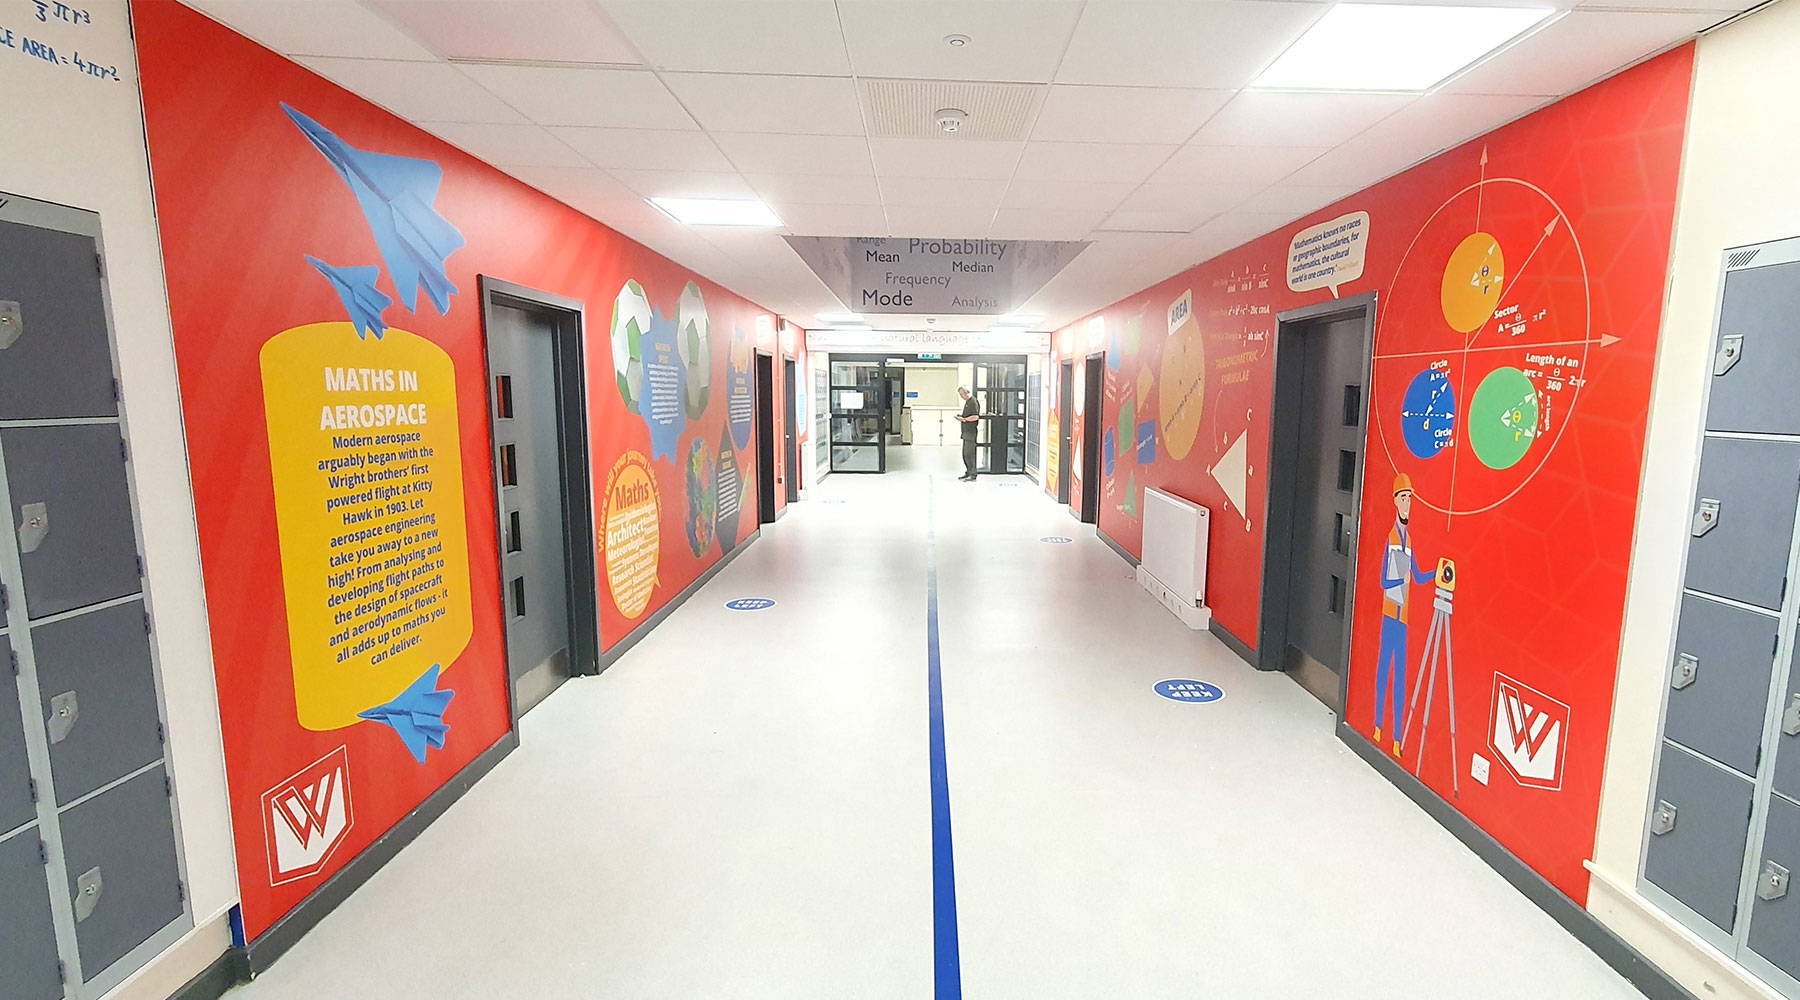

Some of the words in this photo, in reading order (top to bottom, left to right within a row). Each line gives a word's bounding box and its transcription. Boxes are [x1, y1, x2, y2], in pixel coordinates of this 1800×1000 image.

[22, 37, 59, 65] AREA
[1346, 218, 1362, 231] races
[1351, 231, 1360, 243] for
[866, 249, 900, 263] Mean
[909, 238, 1007, 261] Probability
[1321, 253, 1330, 264] the
[1330, 246, 1350, 261] cultural
[952, 261, 994, 273] Median
[1308, 270, 1317, 280] one
[885, 272, 951, 288] Frequency
[862, 289, 913, 306] Mode
[951, 296, 998, 310] Analysis
[1170, 298, 1188, 326] AREA
[1494, 304, 1520, 319] Sector
[1497, 323, 1504, 333] A
[1511, 324, 1526, 336] 360
[1430, 360, 1448, 370] Circle
[1526, 352, 1555, 366] Length
[1555, 356, 1566, 366] of
[325, 367, 395, 392] MATHS
[399, 370, 418, 392] IN
[1430, 373, 1436, 382] A
[1523, 368, 1536, 378] arc
[1546, 380, 1562, 391] 360
[1431, 390, 1437, 399] r
[320, 403, 427, 431] AEROSPACE
[1423, 418, 1430, 431] d
[332, 435, 373, 449] Modern
[375, 432, 421, 446] aerospace
[1434, 428, 1452, 438] Circle
[318, 453, 366, 473] arguably
[367, 452, 397, 466] began
[398, 448, 418, 460] with
[419, 446, 434, 458] the
[328, 474, 366, 490] Wright
[411, 464, 429, 476] first
[326, 490, 373, 512] powered
[375, 485, 400, 503] flight
[402, 484, 411, 494] at
[412, 480, 433, 493] Kitty
[615, 478, 649, 512] Maths
[343, 508, 373, 525] Hawk
[374, 506, 384, 519] in
[386, 501, 409, 515] 1903.
[410, 499, 424, 510] Let
[330, 526, 383, 549] aerospace
[384, 513, 436, 534] engineering
[330, 553, 354, 568] take
[356, 546, 375, 563] you
[377, 539, 402, 555] away
[403, 535, 413, 546] to
[414, 534, 420, 543] a
[421, 528, 439, 541] new
[328, 569, 355, 588] high!
[357, 562, 382, 578] From
[384, 549, 426, 568] analysing
[427, 541, 442, 555] and
[327, 580, 385, 607] developing
[386, 571, 411, 587] flight
[412, 562, 435, 580] paths
[436, 559, 445, 569] to
[334, 611, 353, 625] the
[354, 597, 387, 612] design
[388, 593, 398, 604] of
[399, 574, 443, 600] spacecraft
[329, 627, 350, 647] and
[352, 603, 413, 637] aerodynamic
[414, 595, 437, 610] flows
[442, 588, 449, 599] it
[336, 647, 350, 663] all
[351, 639, 376, 656] adds
[377, 631, 390, 646] up
[391, 627, 401, 638] to
[403, 615, 430, 633] maths
[431, 606, 446, 623] you
[370, 653, 388, 665] can
[389, 635, 422, 655] deliver.
[1171, 690, 1214, 698] KEEP
